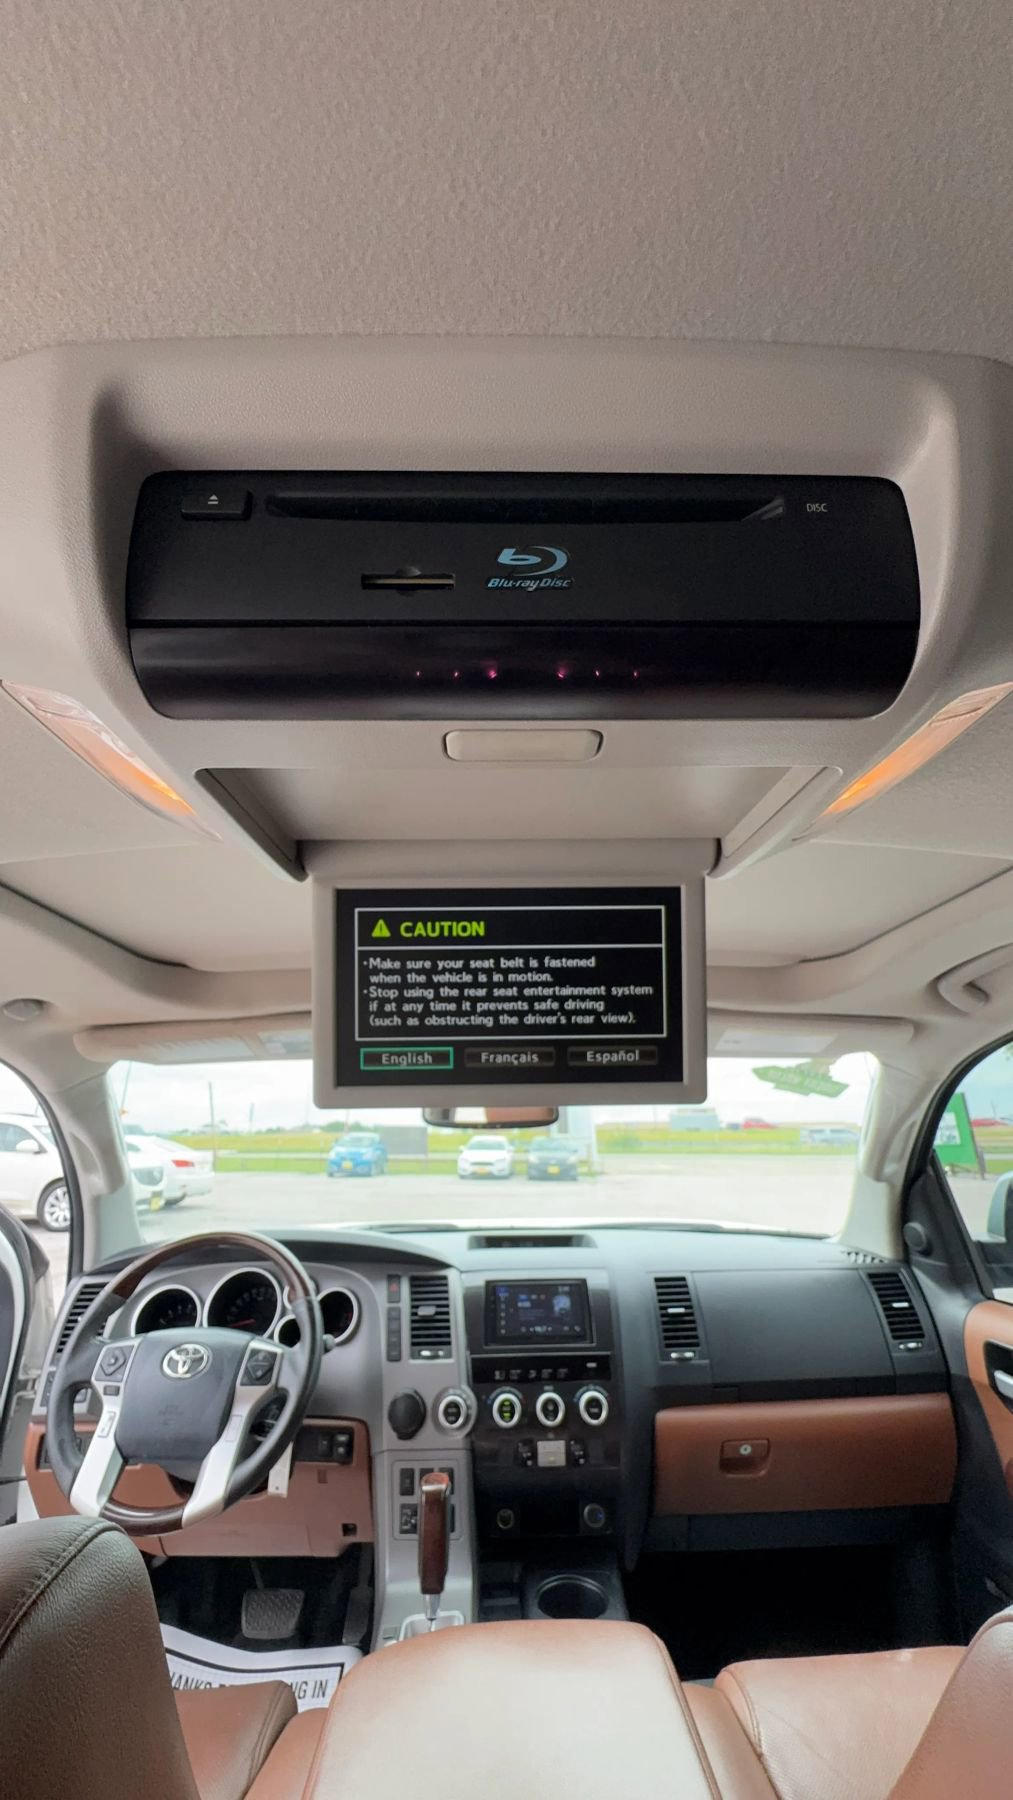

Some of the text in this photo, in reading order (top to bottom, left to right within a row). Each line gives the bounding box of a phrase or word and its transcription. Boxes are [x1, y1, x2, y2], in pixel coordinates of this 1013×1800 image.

[806, 503, 828, 512] DISC
[487, 578, 571, 592] Blu-ray Disc
[400, 921, 485, 937] CAUTION
[369, 956, 596, 972] Make sure your seat belt is fastened
[369, 970, 554, 983] when the vehicle is in motion.
[369, 985, 653, 999] Stop using the rear seat entertainment system
[369, 998, 605, 1013] if at any time it prevents safe driving
[369, 1012, 636, 1027] (such as obstructing the driver's rear view).
[381, 1052, 433, 1067] English
[481, 1050, 539, 1065] Français
[586, 1048, 640, 1064] Español
[312, 1680, 328, 1698] IN
